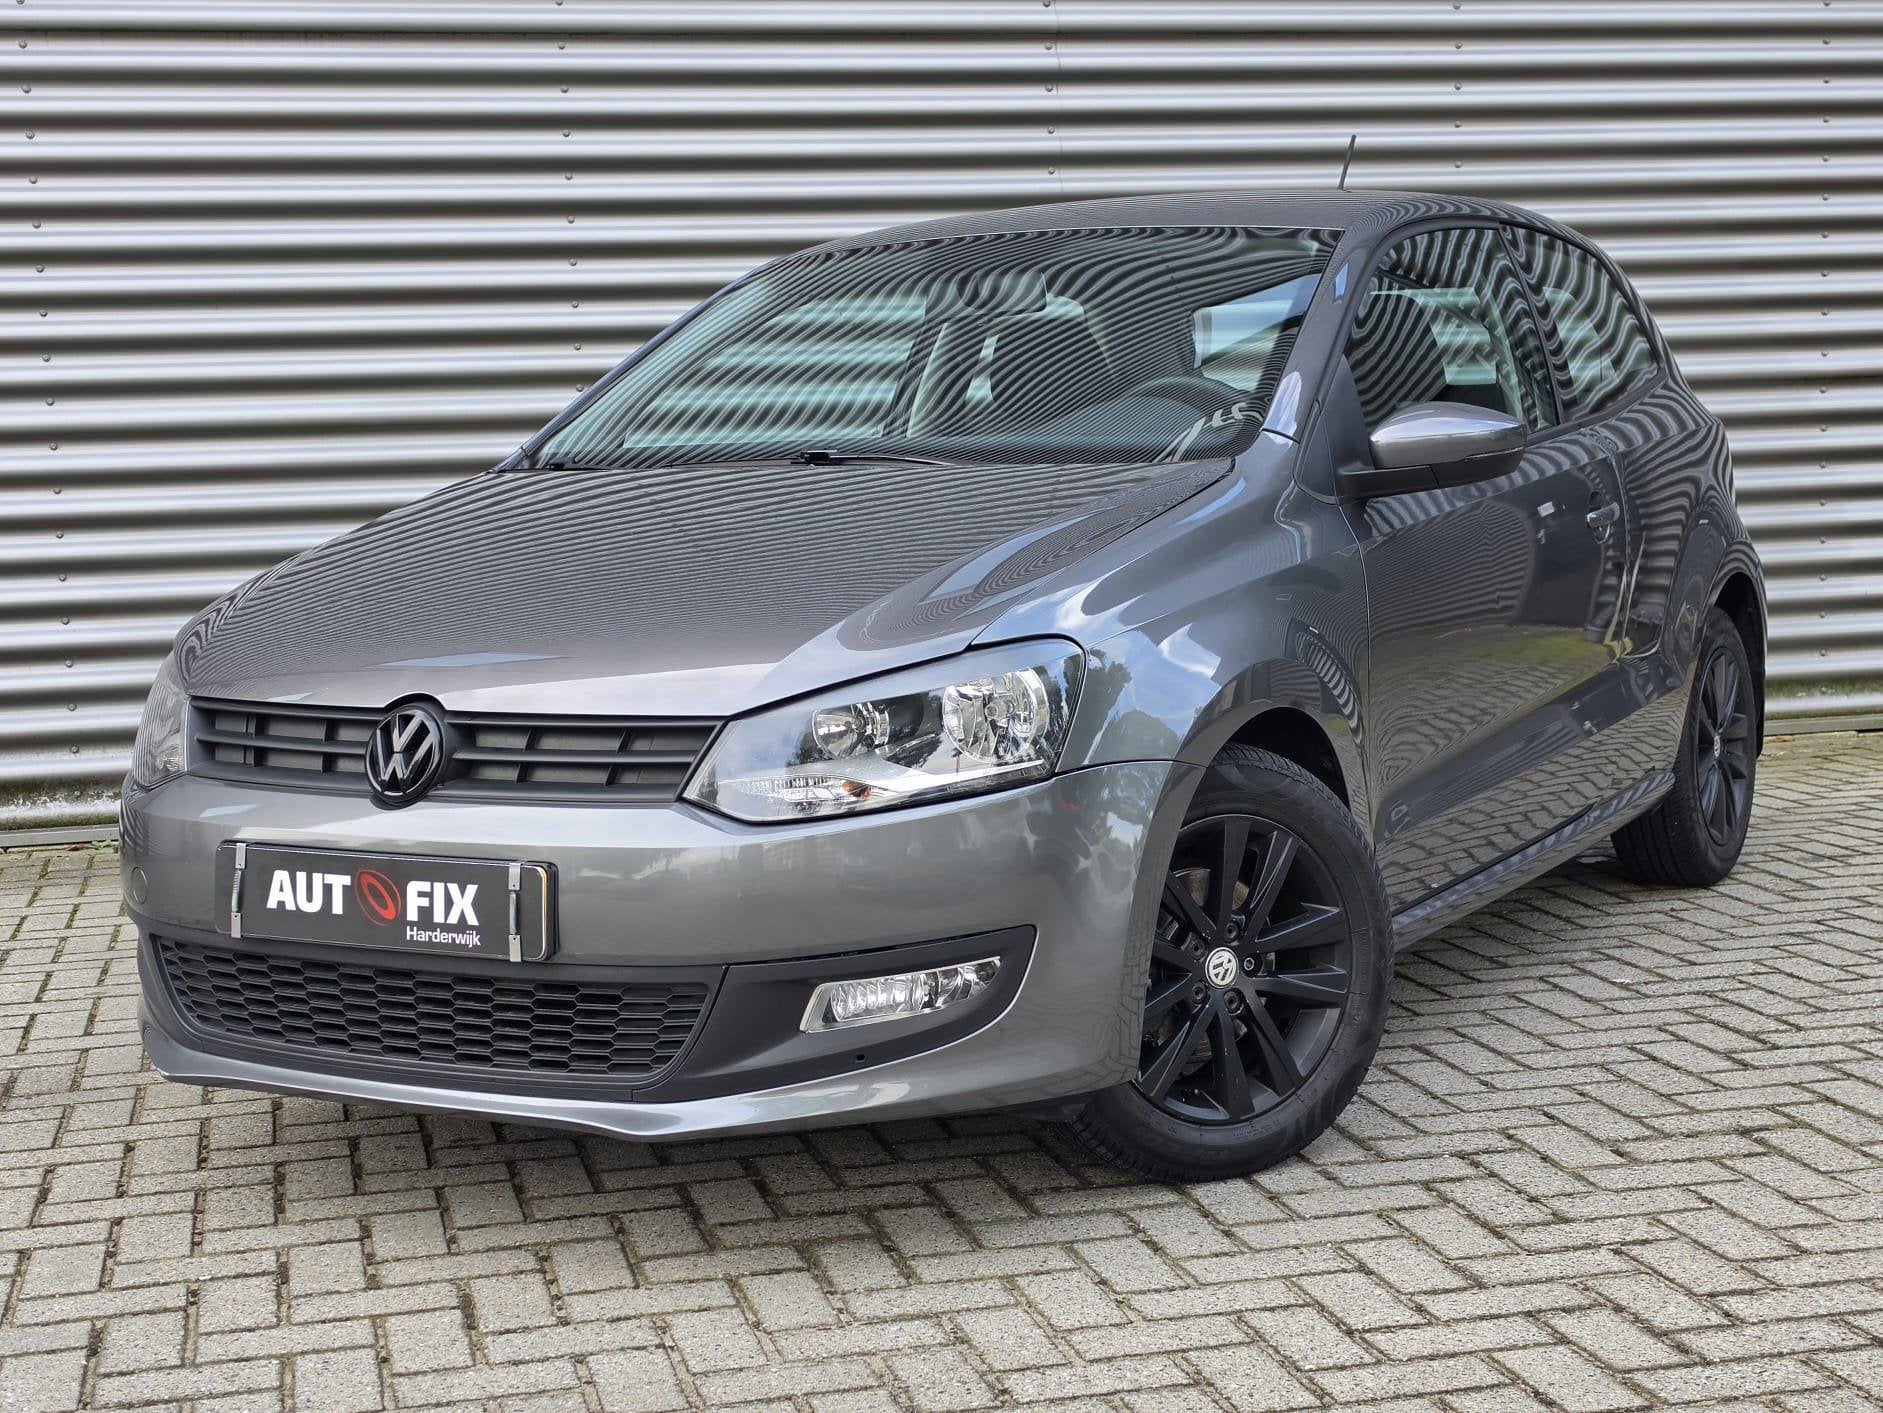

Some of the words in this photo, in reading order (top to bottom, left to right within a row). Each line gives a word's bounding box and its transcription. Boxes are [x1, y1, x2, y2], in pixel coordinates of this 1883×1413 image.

[368, 706, 442, 794] VW
[406, 881, 480, 926] FIX
[406, 925, 481, 948] Harderwijk
